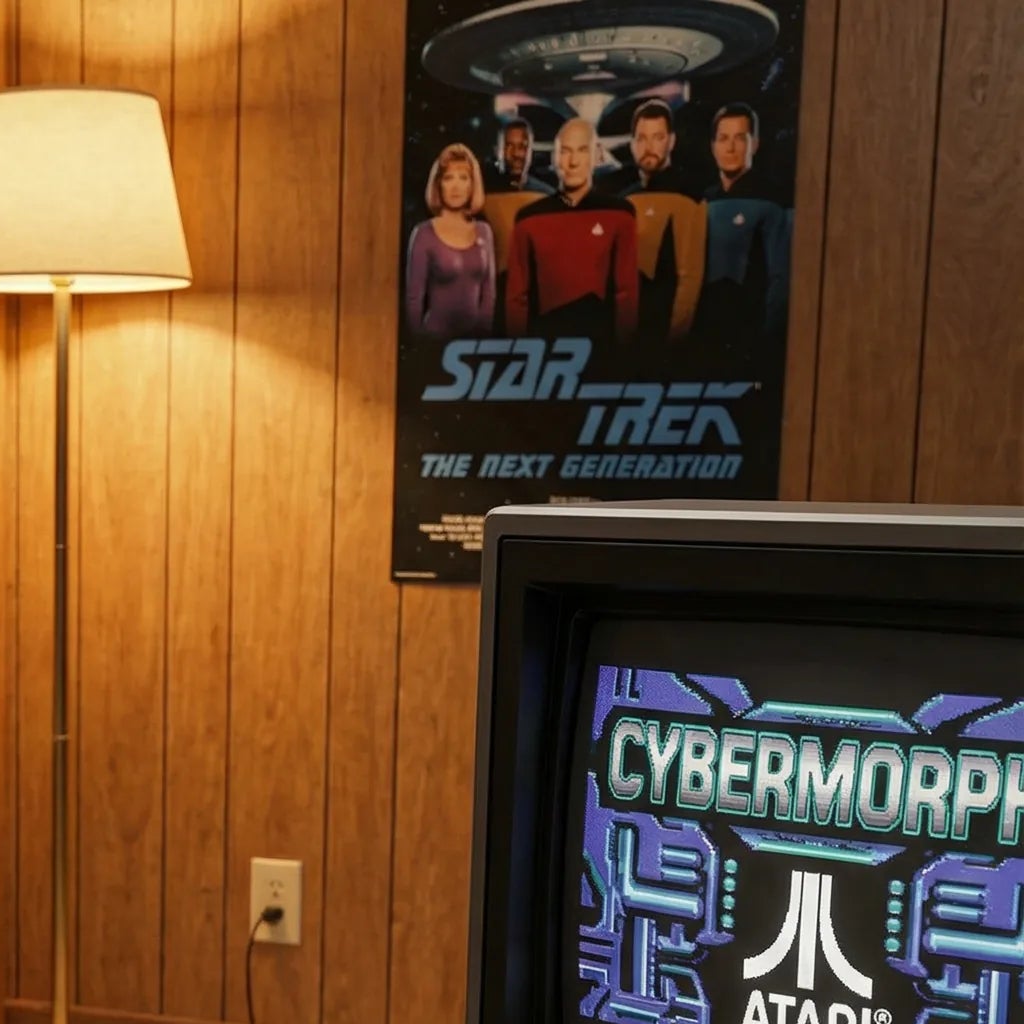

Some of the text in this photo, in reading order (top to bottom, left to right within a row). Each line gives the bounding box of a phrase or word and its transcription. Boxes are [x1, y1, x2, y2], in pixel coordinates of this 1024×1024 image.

[422, 337, 593, 401] STAR
[576, 382, 754, 446] TREK
[422, 454, 744, 480] THE NEXT GENERATION
